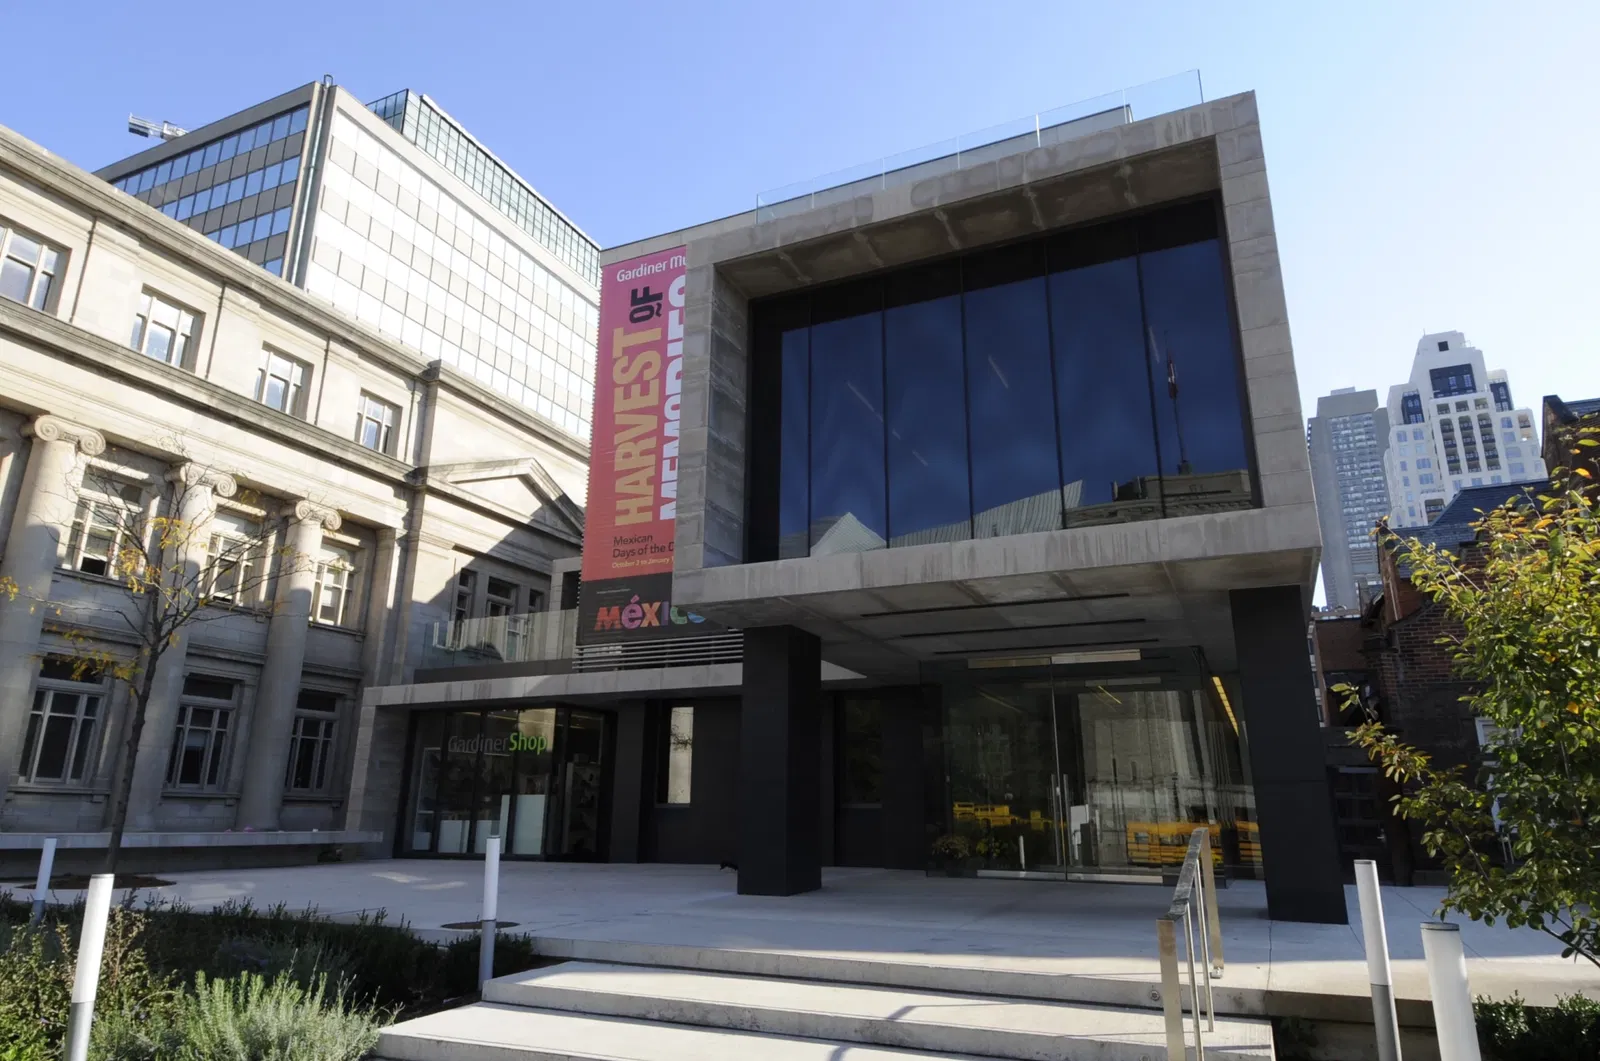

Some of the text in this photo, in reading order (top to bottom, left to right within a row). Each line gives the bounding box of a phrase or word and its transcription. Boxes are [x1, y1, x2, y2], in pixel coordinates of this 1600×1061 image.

[616, 260, 668, 282] Gardiner
[613, 286, 663, 526] HARVEST OF
[613, 534, 653, 545] Mexican
[612, 548, 636, 560] Days
[637, 544, 649, 556] of
[650, 543, 666, 554] the
